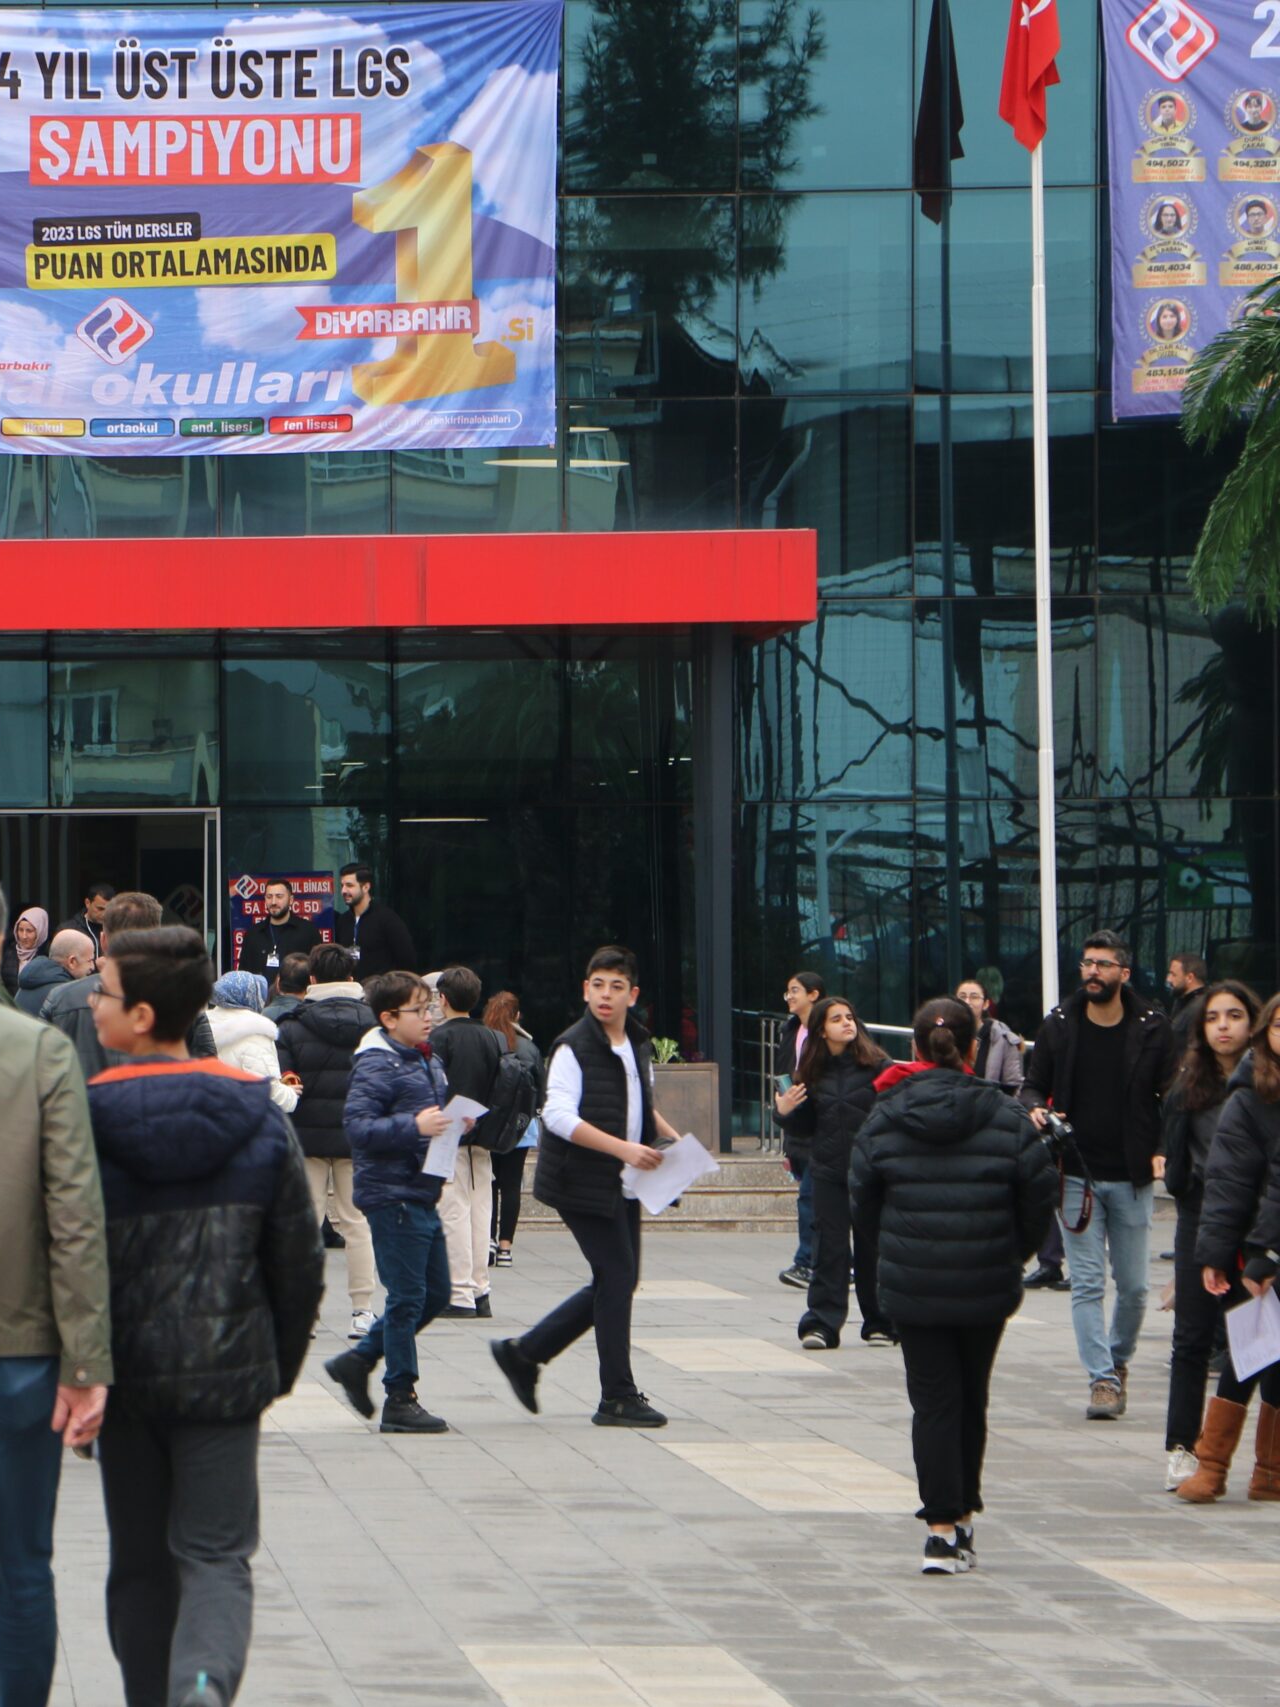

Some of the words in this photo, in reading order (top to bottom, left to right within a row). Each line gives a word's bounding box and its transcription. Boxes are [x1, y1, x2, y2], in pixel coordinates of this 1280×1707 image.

[35, 51, 101, 100] YIL
[115, 39, 196, 100] ÜST
[210, 38, 318, 99] ÜSTE
[331, 48, 410, 98] LGS
[38, 118, 352, 181] ŞAMPİYONU
[41, 226, 74, 242] 2023
[77, 224, 102, 240] LGS
[104, 221, 132, 240] TÜM
[135, 221, 193, 239] DERSLER
[33, 252, 103, 281] PUAN
[111, 244, 328, 279] ORTALAMASINDA
[91, 362, 344, 406] okulları
[23, 421, 64, 433] ilkokul
[106, 421, 158, 434] ortaokul
[190, 421, 218, 434] and.
[220, 421, 253, 433] lisesi
[283, 419, 304, 431] fen
[306, 418, 338, 431] lisesi
[303, 880, 331, 893] BİNASI
[245, 903, 261, 914] 5A
[303, 902, 319, 913] 5D
